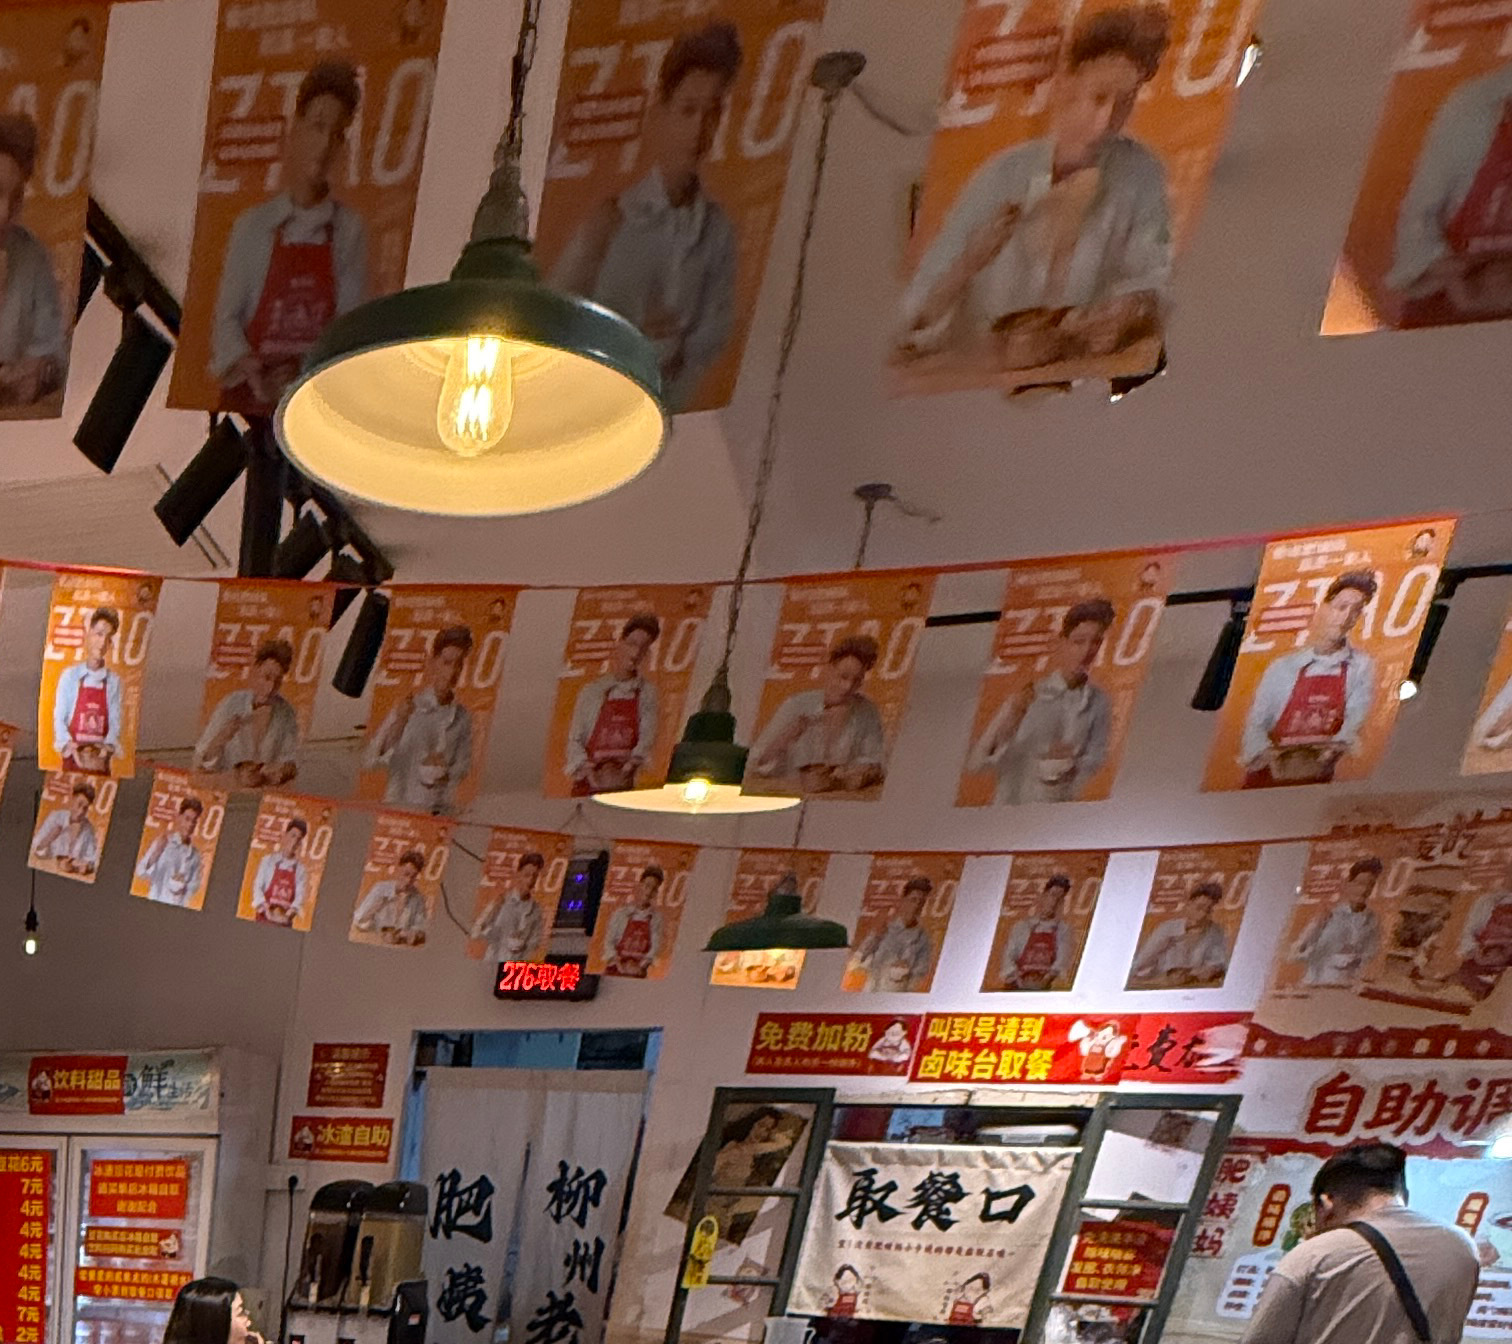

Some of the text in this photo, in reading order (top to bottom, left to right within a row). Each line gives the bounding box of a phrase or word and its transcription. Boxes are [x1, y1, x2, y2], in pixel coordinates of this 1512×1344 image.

[499, 962, 580, 991] 276取餐
[759, 1020, 873, 1053] 免费加粉
[927, 1016, 1045, 1045] 叫到号请到
[918, 1048, 1054, 1081] 卤味台取餐
[53, 1069, 121, 1090] 饮料甜品
[317, 1123, 390, 1147] 冰渣自助
[21, 1178, 44, 1195] 7元
[20, 1200, 44, 1217] 4元
[835, 1168, 1036, 1231] 取餐口
[1193, 1157, 1250, 1256] 肥姨妈
[19, 1222, 43, 1239] 4元
[19, 1243, 43, 1259] 4元
[18, 1264, 42, 1280] 4元
[18, 1286, 41, 1302] 4元
[17, 1306, 40, 1322] 7元
[16, 1326, 39, 1343] 2元
